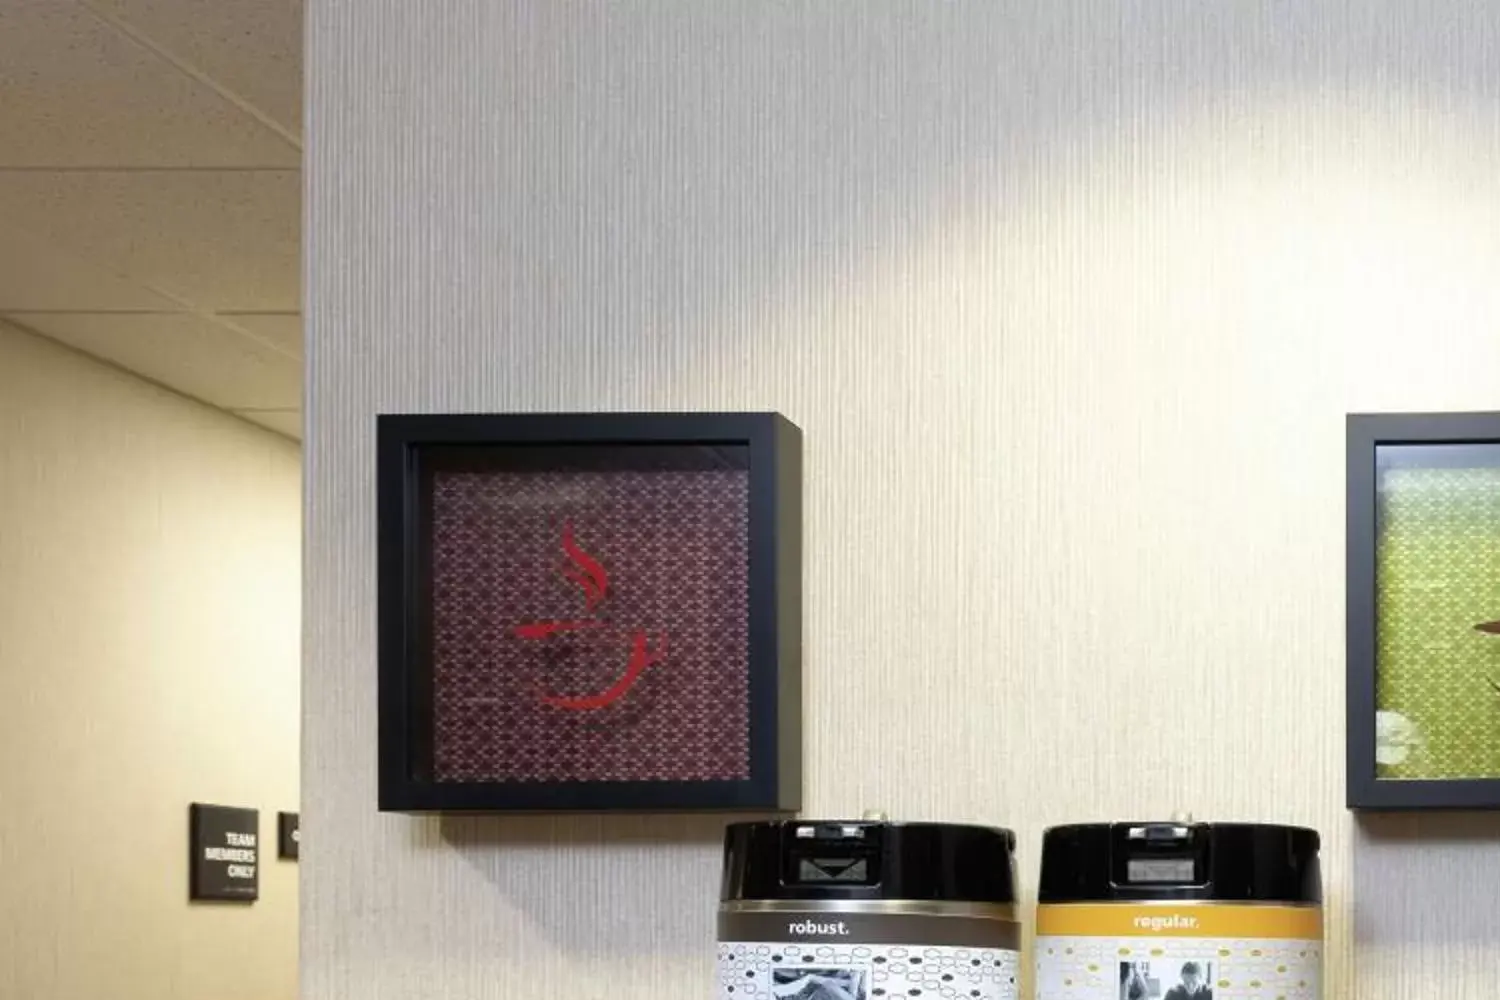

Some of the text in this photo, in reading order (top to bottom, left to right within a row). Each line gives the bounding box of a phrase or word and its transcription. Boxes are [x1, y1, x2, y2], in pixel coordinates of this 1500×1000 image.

[225, 831, 256, 847] TEAM
[204, 847, 256, 863] MEMBERS
[227, 863, 256, 879] ONLY
[789, 919, 849, 935] robust.
[1133, 913, 1200, 932] regular.
